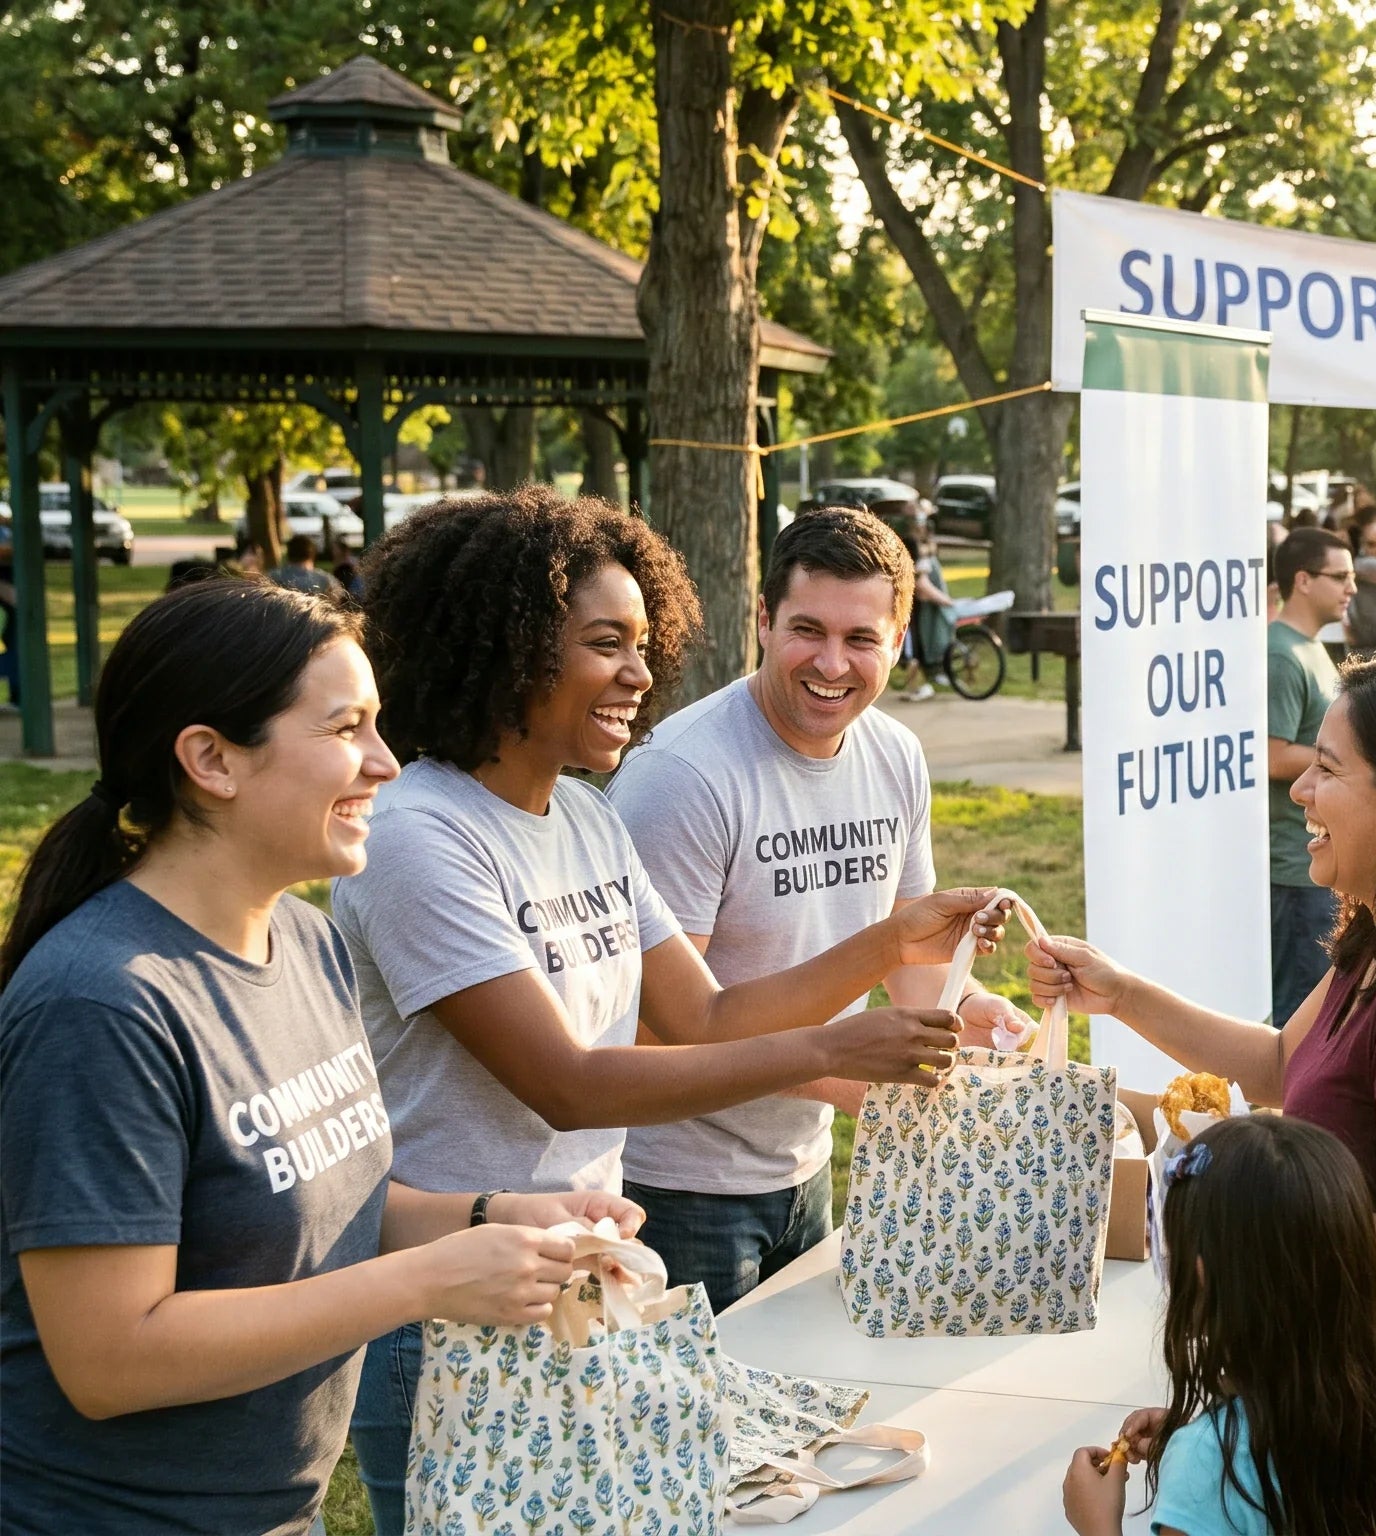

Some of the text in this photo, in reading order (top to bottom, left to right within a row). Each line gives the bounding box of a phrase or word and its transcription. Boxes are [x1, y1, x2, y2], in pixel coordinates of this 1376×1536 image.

[1094, 557, 1265, 631] SUPPORT
[1146, 648, 1227, 717] OUR
[1117, 730, 1256, 816] FUTURE
[755, 817, 899, 864] COMMUNITY
[774, 853, 888, 897] BUILDERS
[544, 919, 639, 974] BUIDERS
[262, 1092, 391, 1194] BUILDERS
